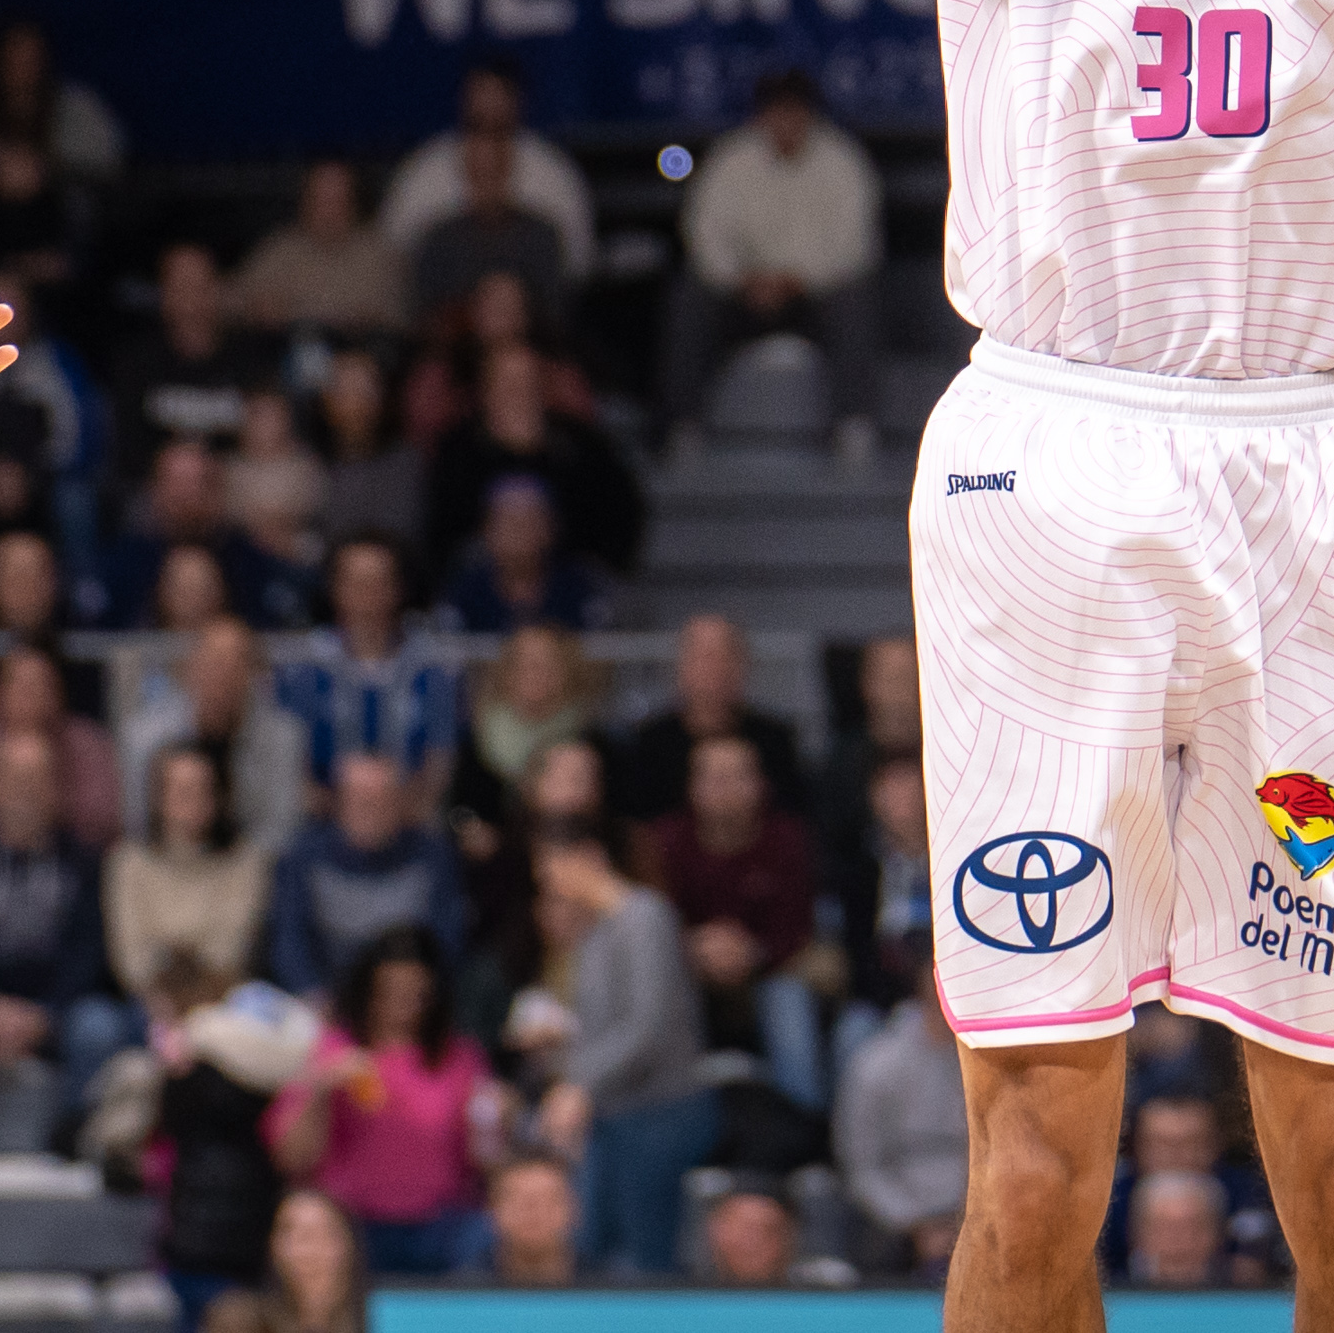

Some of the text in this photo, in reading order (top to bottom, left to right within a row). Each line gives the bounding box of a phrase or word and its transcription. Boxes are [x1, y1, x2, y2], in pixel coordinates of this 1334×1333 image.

[1130, 5, 1272, 142] 30
[947, 470, 1016, 496] SPALDING
[1241, 914, 1291, 961] del
